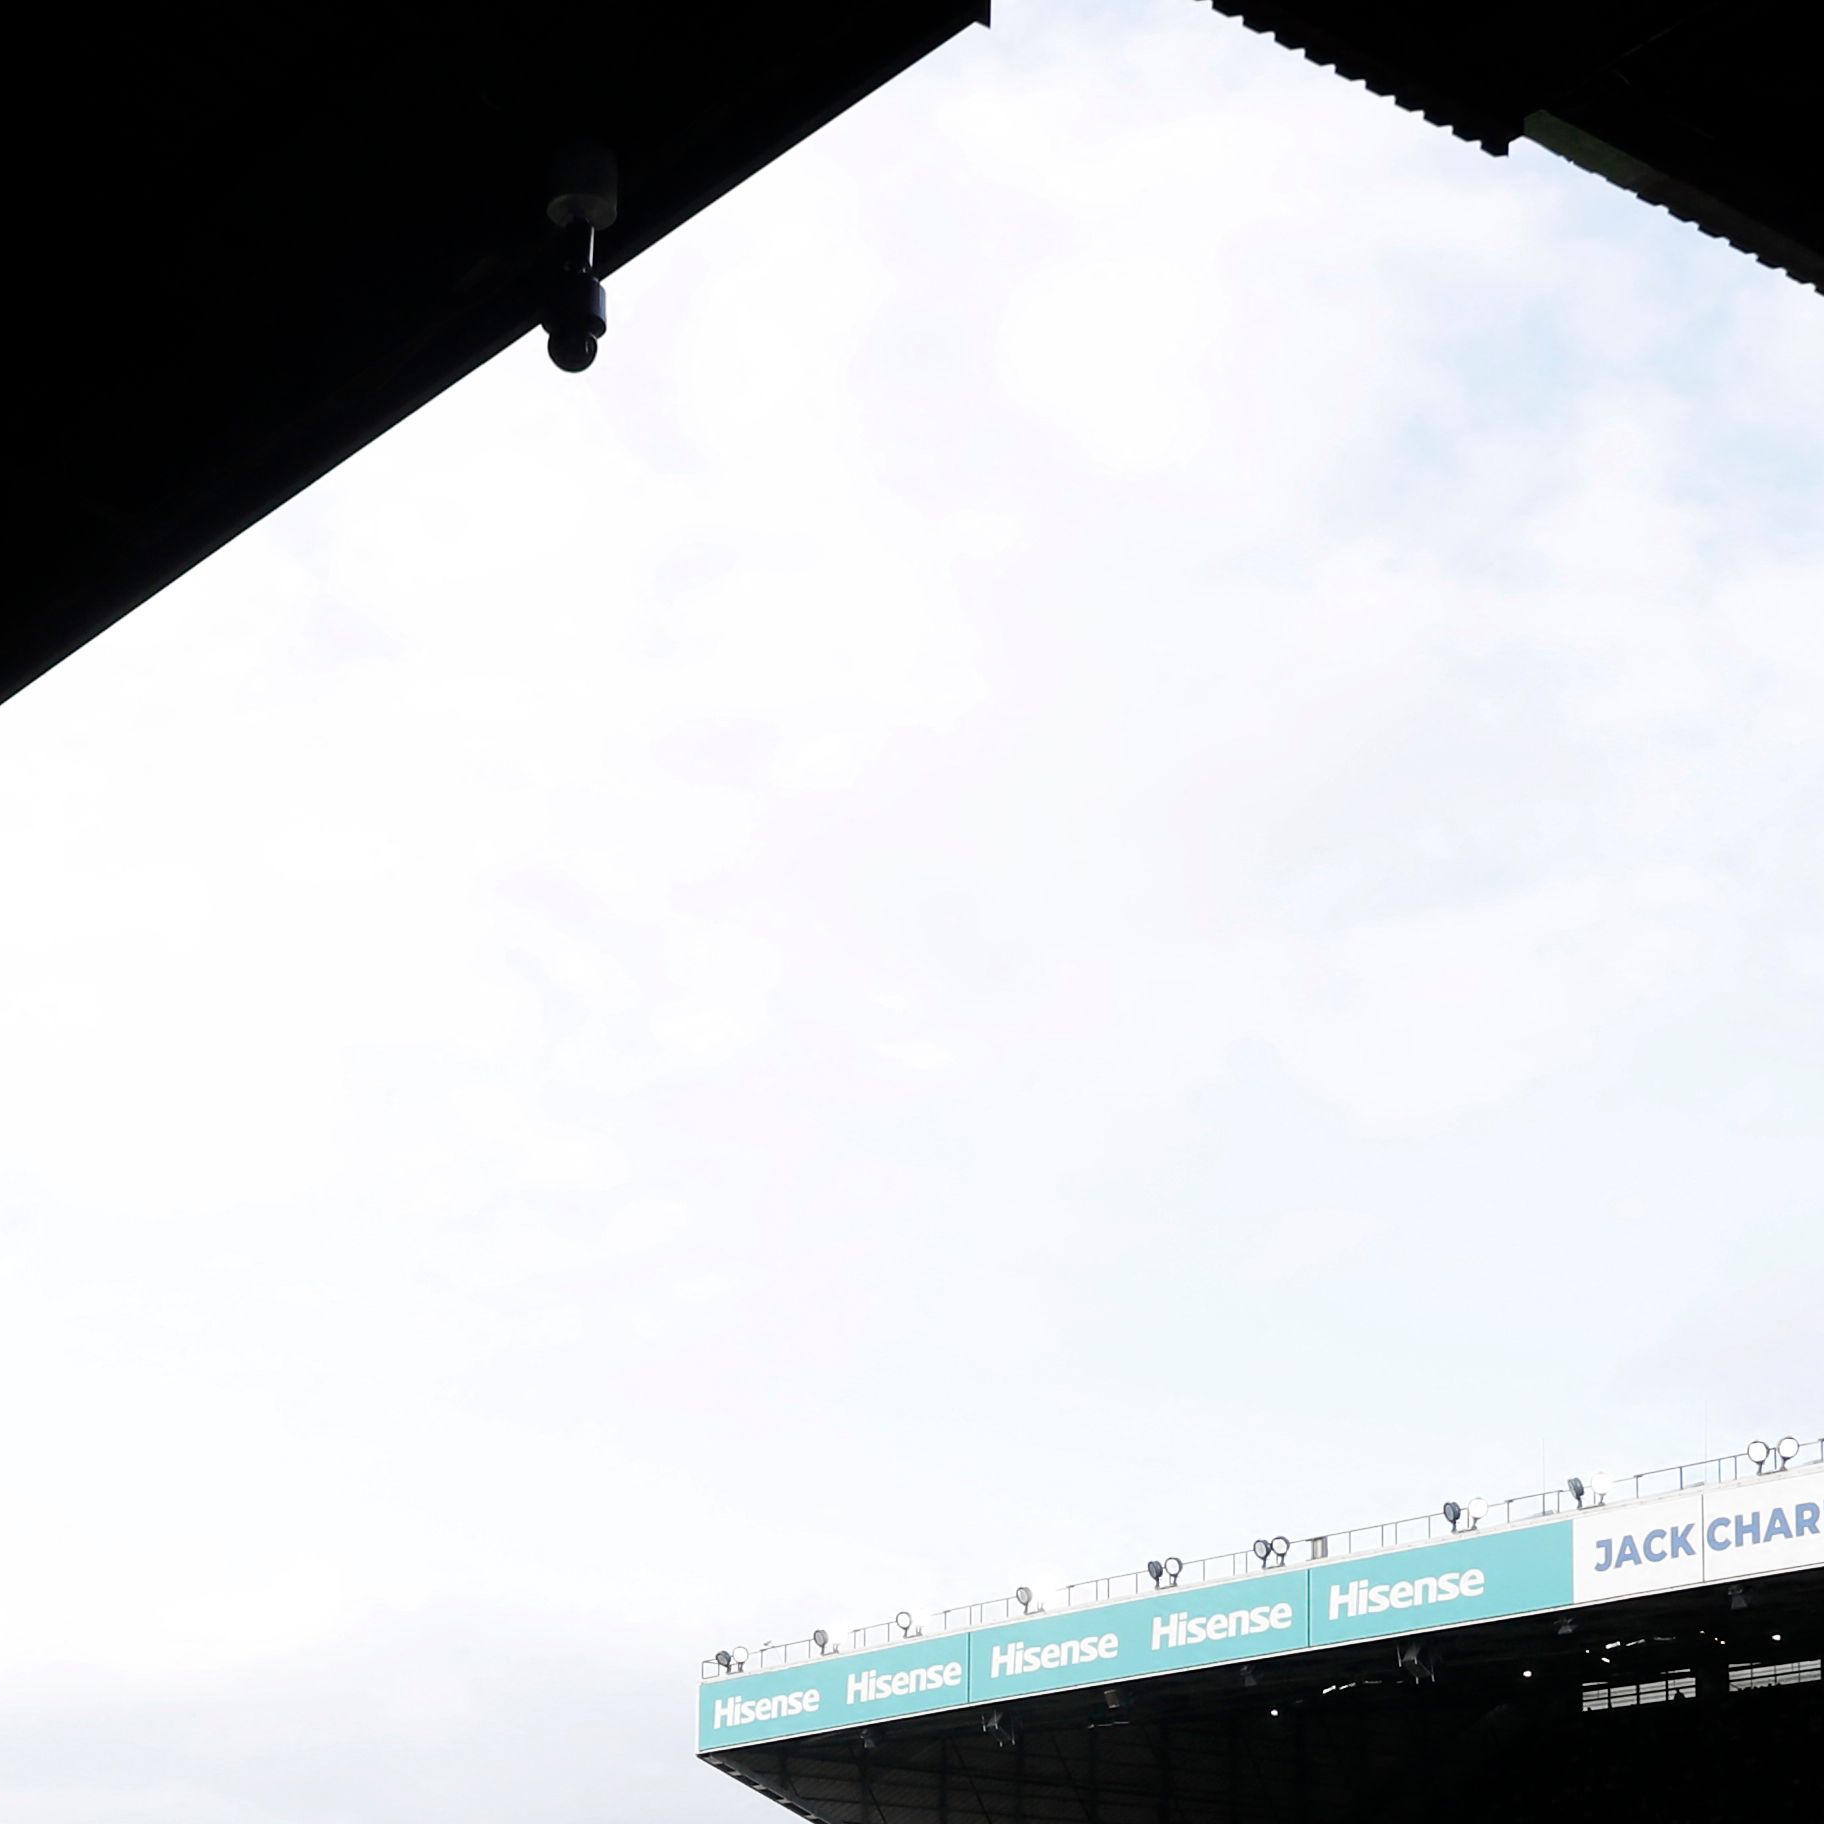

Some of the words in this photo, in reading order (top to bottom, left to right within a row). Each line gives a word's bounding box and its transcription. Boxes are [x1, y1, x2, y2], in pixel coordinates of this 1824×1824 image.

[1595, 1523, 1695, 1572] JACK
[1328, 1568, 1485, 1620] Hisense
[1151, 1602, 1292, 1650] Hisense
[991, 1633, 1118, 1678] Hisense
[846, 1661, 961, 1704] Hisense
[713, 1688, 820, 1729] Hisense
